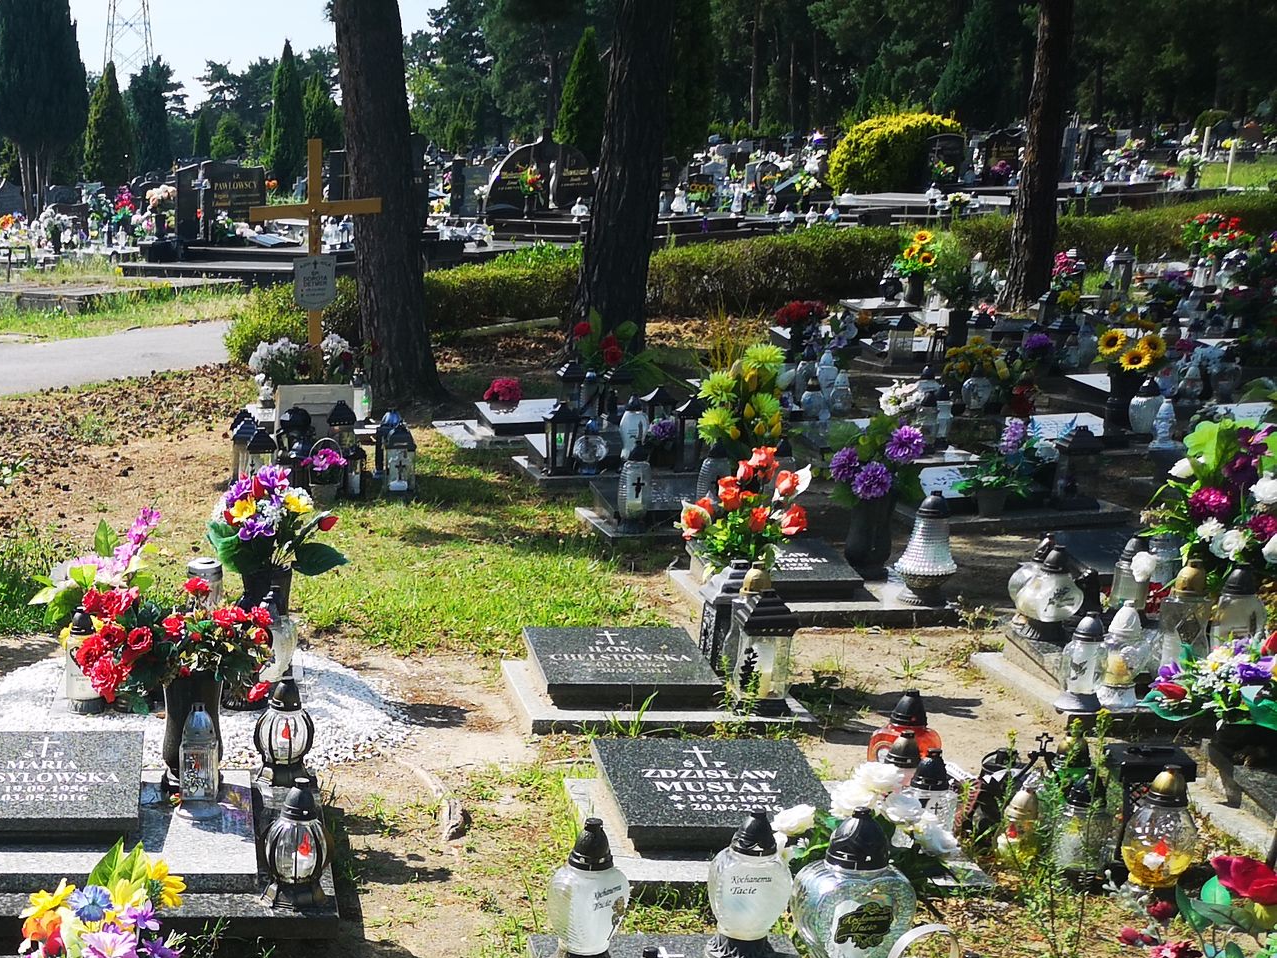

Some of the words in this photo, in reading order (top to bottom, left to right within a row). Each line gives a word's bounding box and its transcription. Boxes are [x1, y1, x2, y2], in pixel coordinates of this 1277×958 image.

[588, 645, 644, 653] ILONA
[6, 760, 78, 769] MARIA
[5, 785, 89, 793] 19.09.1956
[688, 794, 777, 803] 19.12.1957
[730, 874, 772, 884] Kochanemu
[730, 886, 757, 895] Tacie
